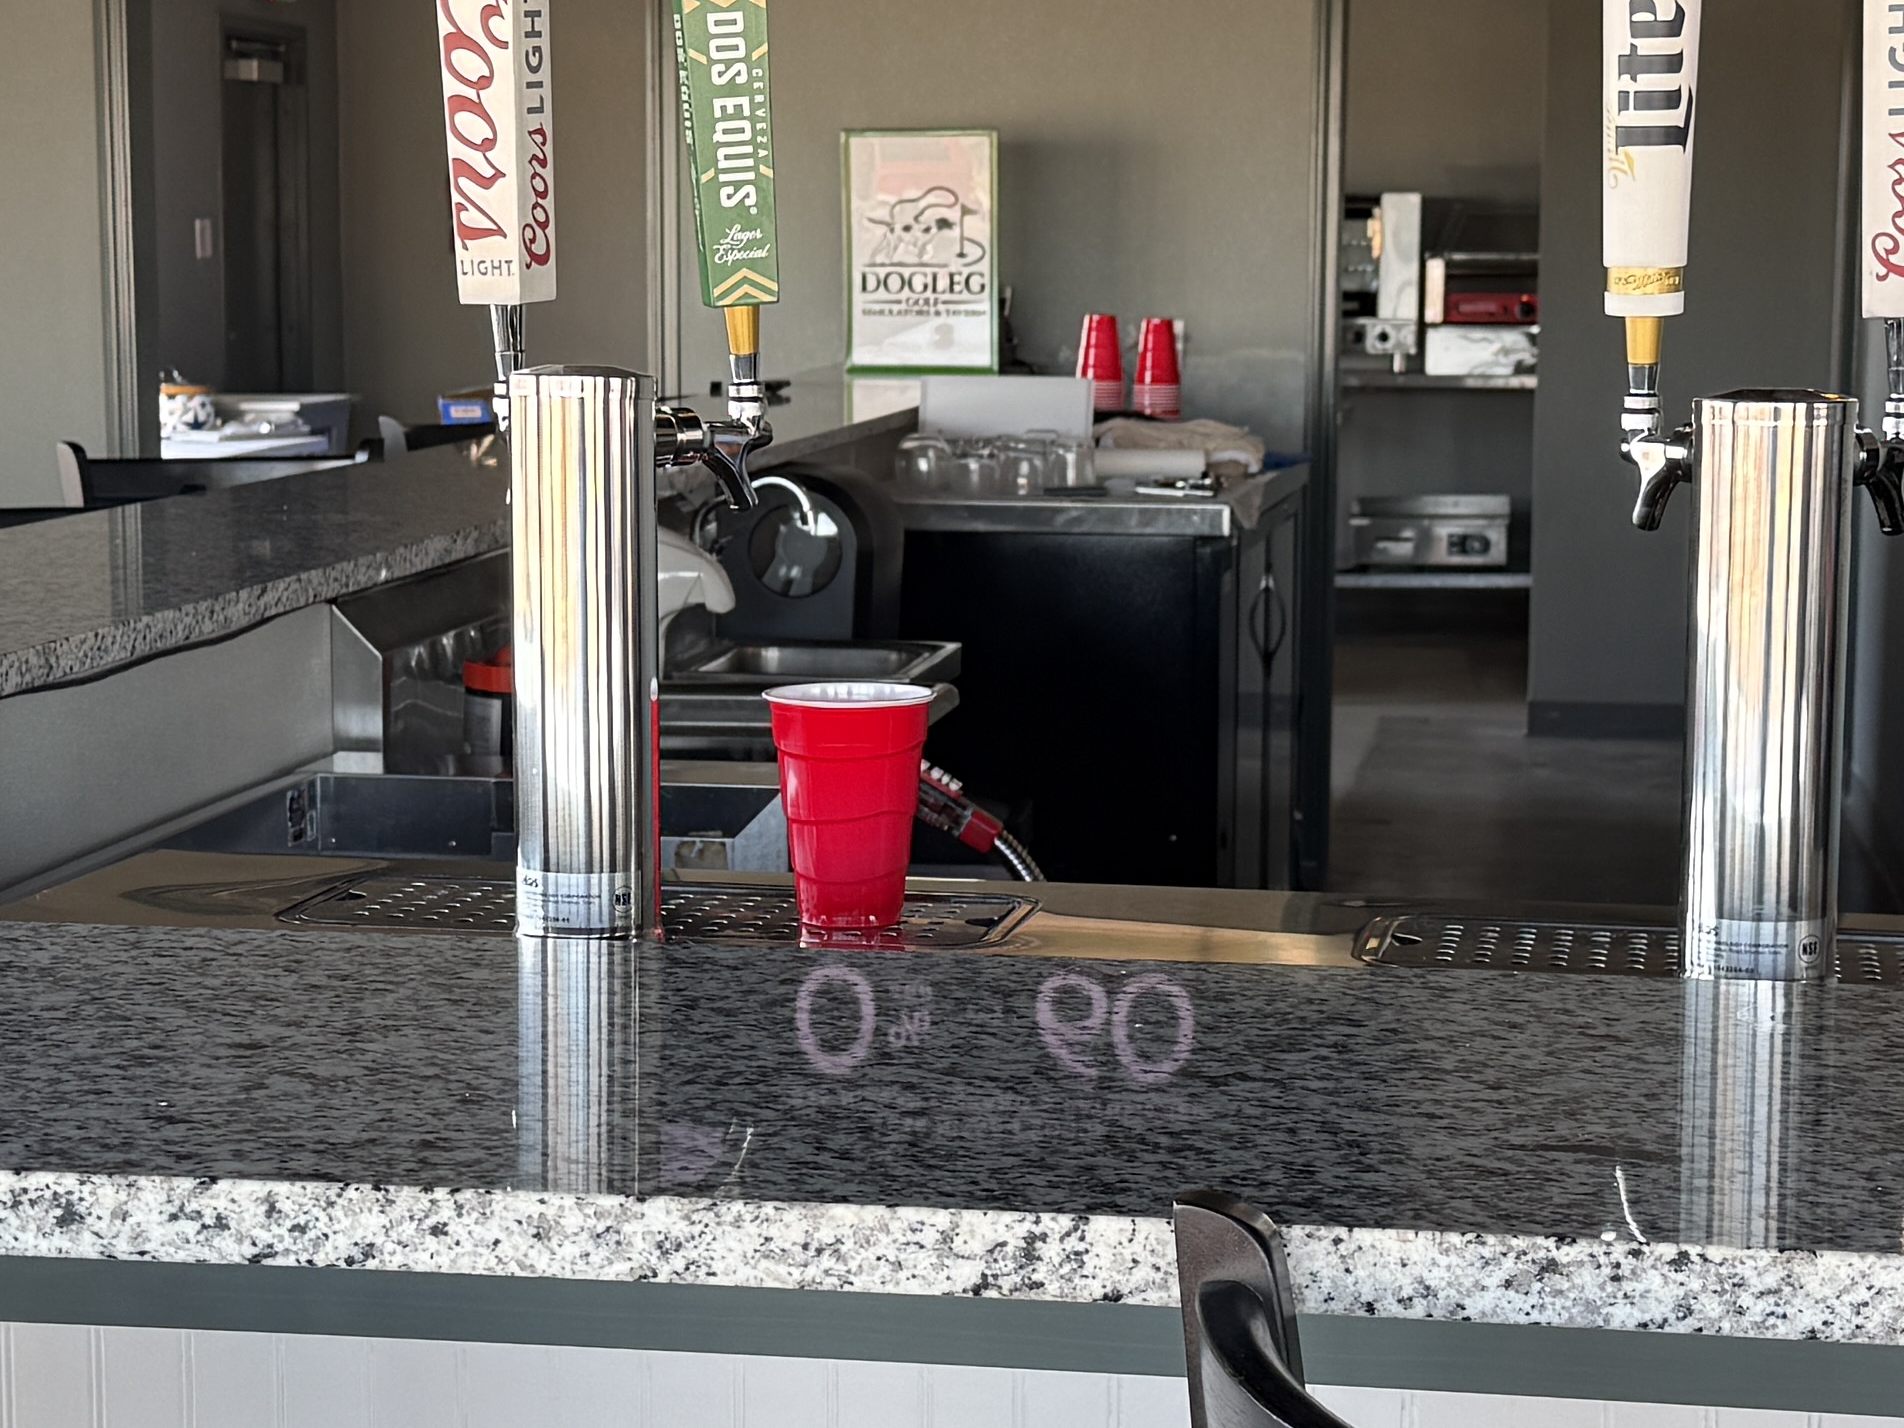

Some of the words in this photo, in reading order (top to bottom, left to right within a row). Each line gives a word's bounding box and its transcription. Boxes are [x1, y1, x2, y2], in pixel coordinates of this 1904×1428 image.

[706, 11, 749, 86] DOS
[751, 68, 769, 158] CERVEZA
[712, 96, 758, 209] EQUIS
[521, 122, 552, 270] Coors
[720, 224, 763, 248] Lager
[459, 259, 511, 276] LIGHT
[712, 244, 770, 267] Especial
[860, 271, 986, 295] DOGLEG
[1802, 941, 1818, 956] NSF
